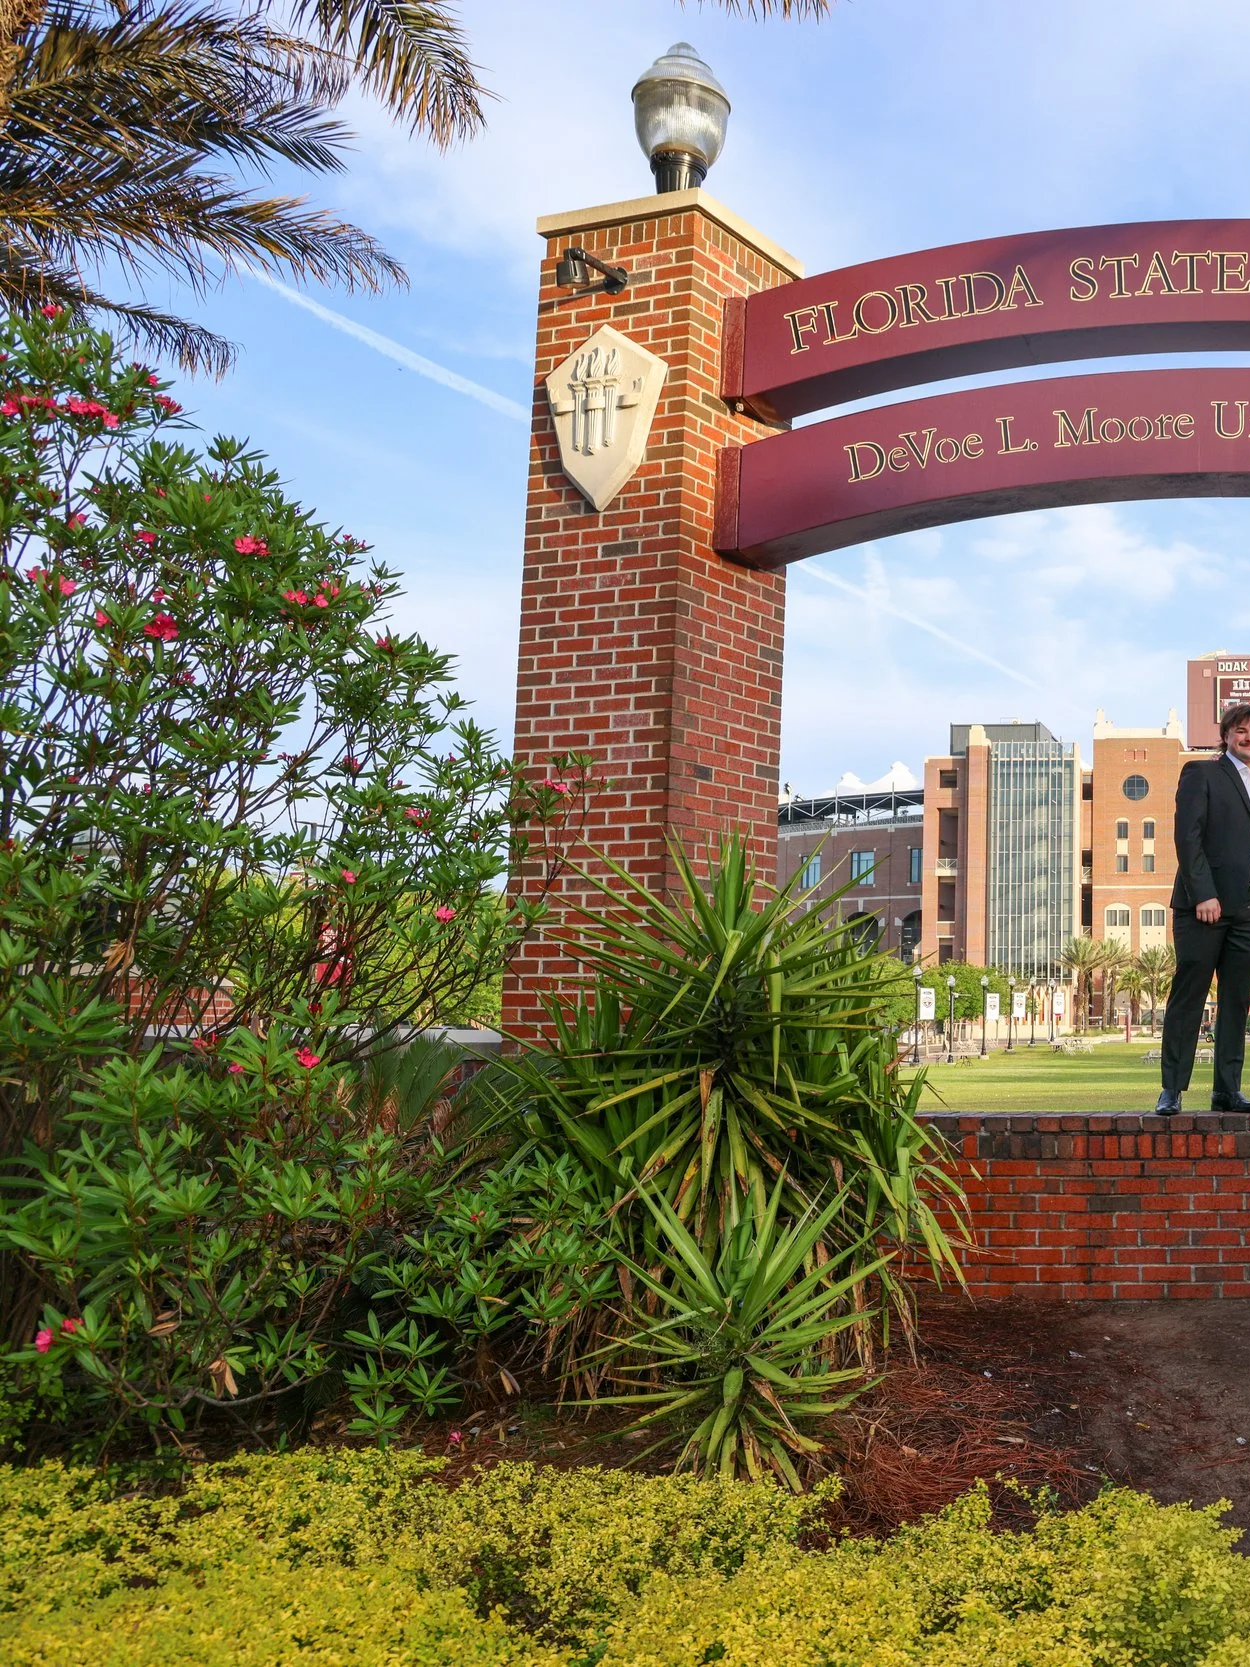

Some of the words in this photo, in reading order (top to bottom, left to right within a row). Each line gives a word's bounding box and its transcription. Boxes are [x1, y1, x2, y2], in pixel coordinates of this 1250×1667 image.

[783, 264, 1043, 354] FLORIDA
[843, 428, 984, 483] DeVoe
[996, 416, 1039, 455] L.
[1052, 407, 1195, 447] Moore
[1217, 661, 1249, 672] DOAK
